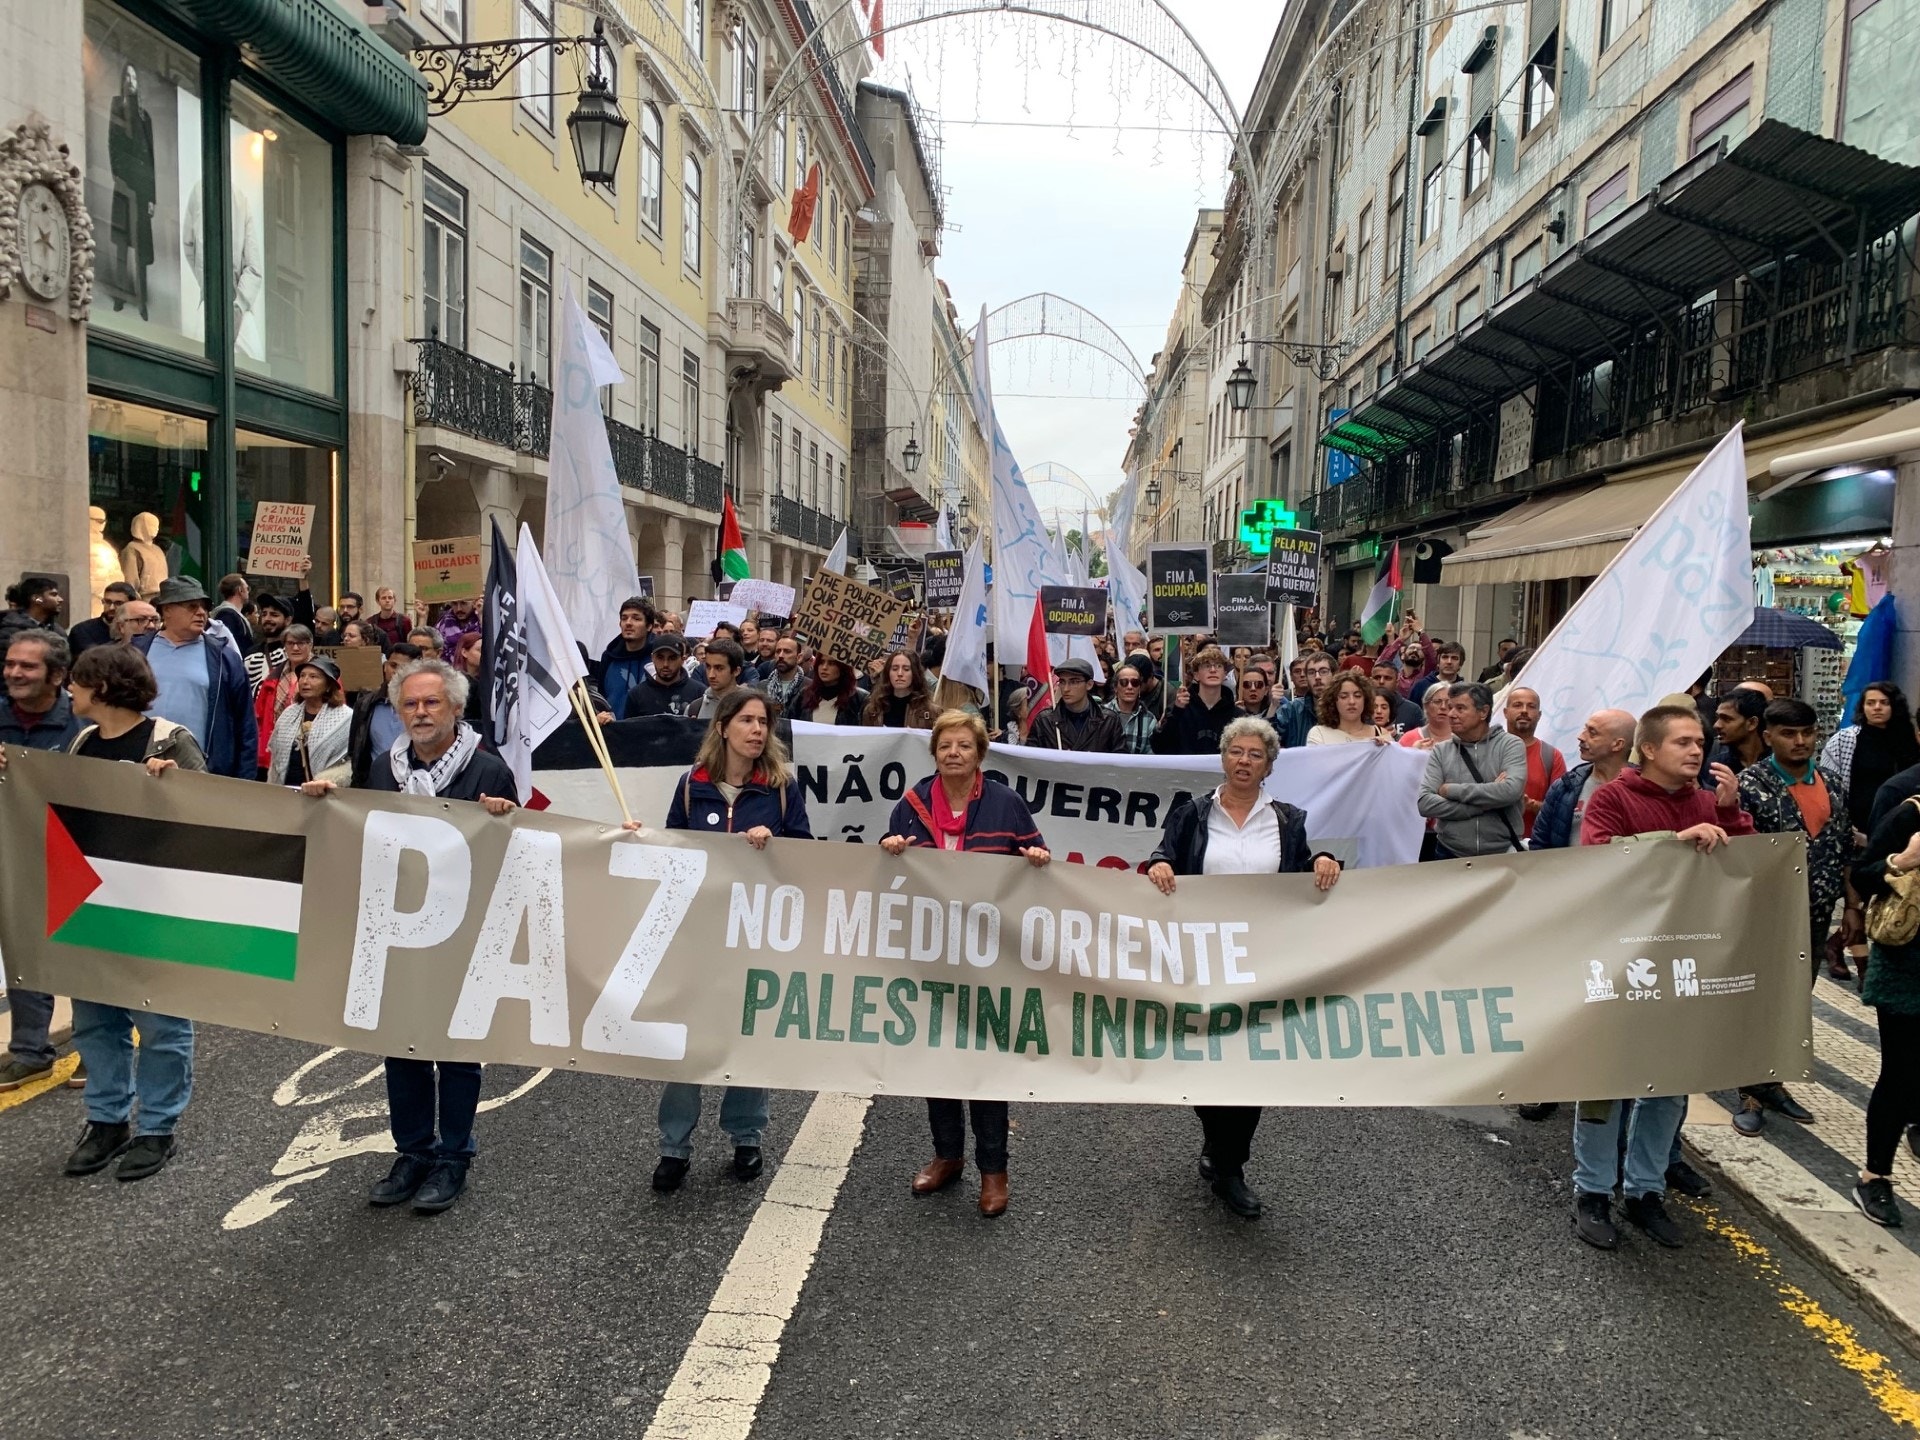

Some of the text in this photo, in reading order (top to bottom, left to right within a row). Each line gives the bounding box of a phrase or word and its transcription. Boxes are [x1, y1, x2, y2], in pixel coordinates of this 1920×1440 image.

[285, 506, 306, 515] MIL
[256, 524, 286, 532] MORTAS
[255, 533, 303, 545] PALESTINA
[1274, 536, 1296, 551] PELA
[1298, 540, 1317, 554] PAZ!
[431, 543, 455, 555] ONE
[1282, 549, 1299, 564] NÃO
[265, 560, 300, 572] CRIME
[414, 554, 480, 570] HOLOCAUST
[927, 559, 961, 569] PELA PAZ!
[935, 567, 948, 577] NÃO
[1166, 568, 1195, 583] FIM À
[1271, 562, 1316, 580] ESCALADA
[928, 578, 963, 588] ESCALADA
[1155, 582, 1207, 598] OCUPAÇÃO
[1269, 575, 1316, 593] DA GUERRA
[818, 571, 902, 615] THE POWER OF
[927, 586, 960, 597] DA GUERR
[1061, 597, 1085, 610] FIM À
[1248, 595, 1255, 604] À
[812, 587, 838, 608] OUR
[840, 598, 885, 628] PEOPLE
[1220, 604, 1267, 612] OCUPAÇÃO
[806, 601, 887, 645] IS STRONGER
[1049, 610, 1095, 625] OCUPAÇÃO
[797, 613, 830, 638] THAN
[832, 627, 854, 648] THE
[806, 636, 822, 651] IN
[798, 753, 906, 805] NÃO
[344, 809, 708, 1060] PAZ
[725, 875, 1256, 987] NO MÉDIO ORIENTE
[1620, 933, 1722, 944] ORGANIZAÇÕES PROMOTORAS
[1589, 987, 1613, 997] CGTP
[1626, 989, 1661, 1001] CPPC
[741, 968, 1524, 1062] PALESTINA INDEPENDENTE
